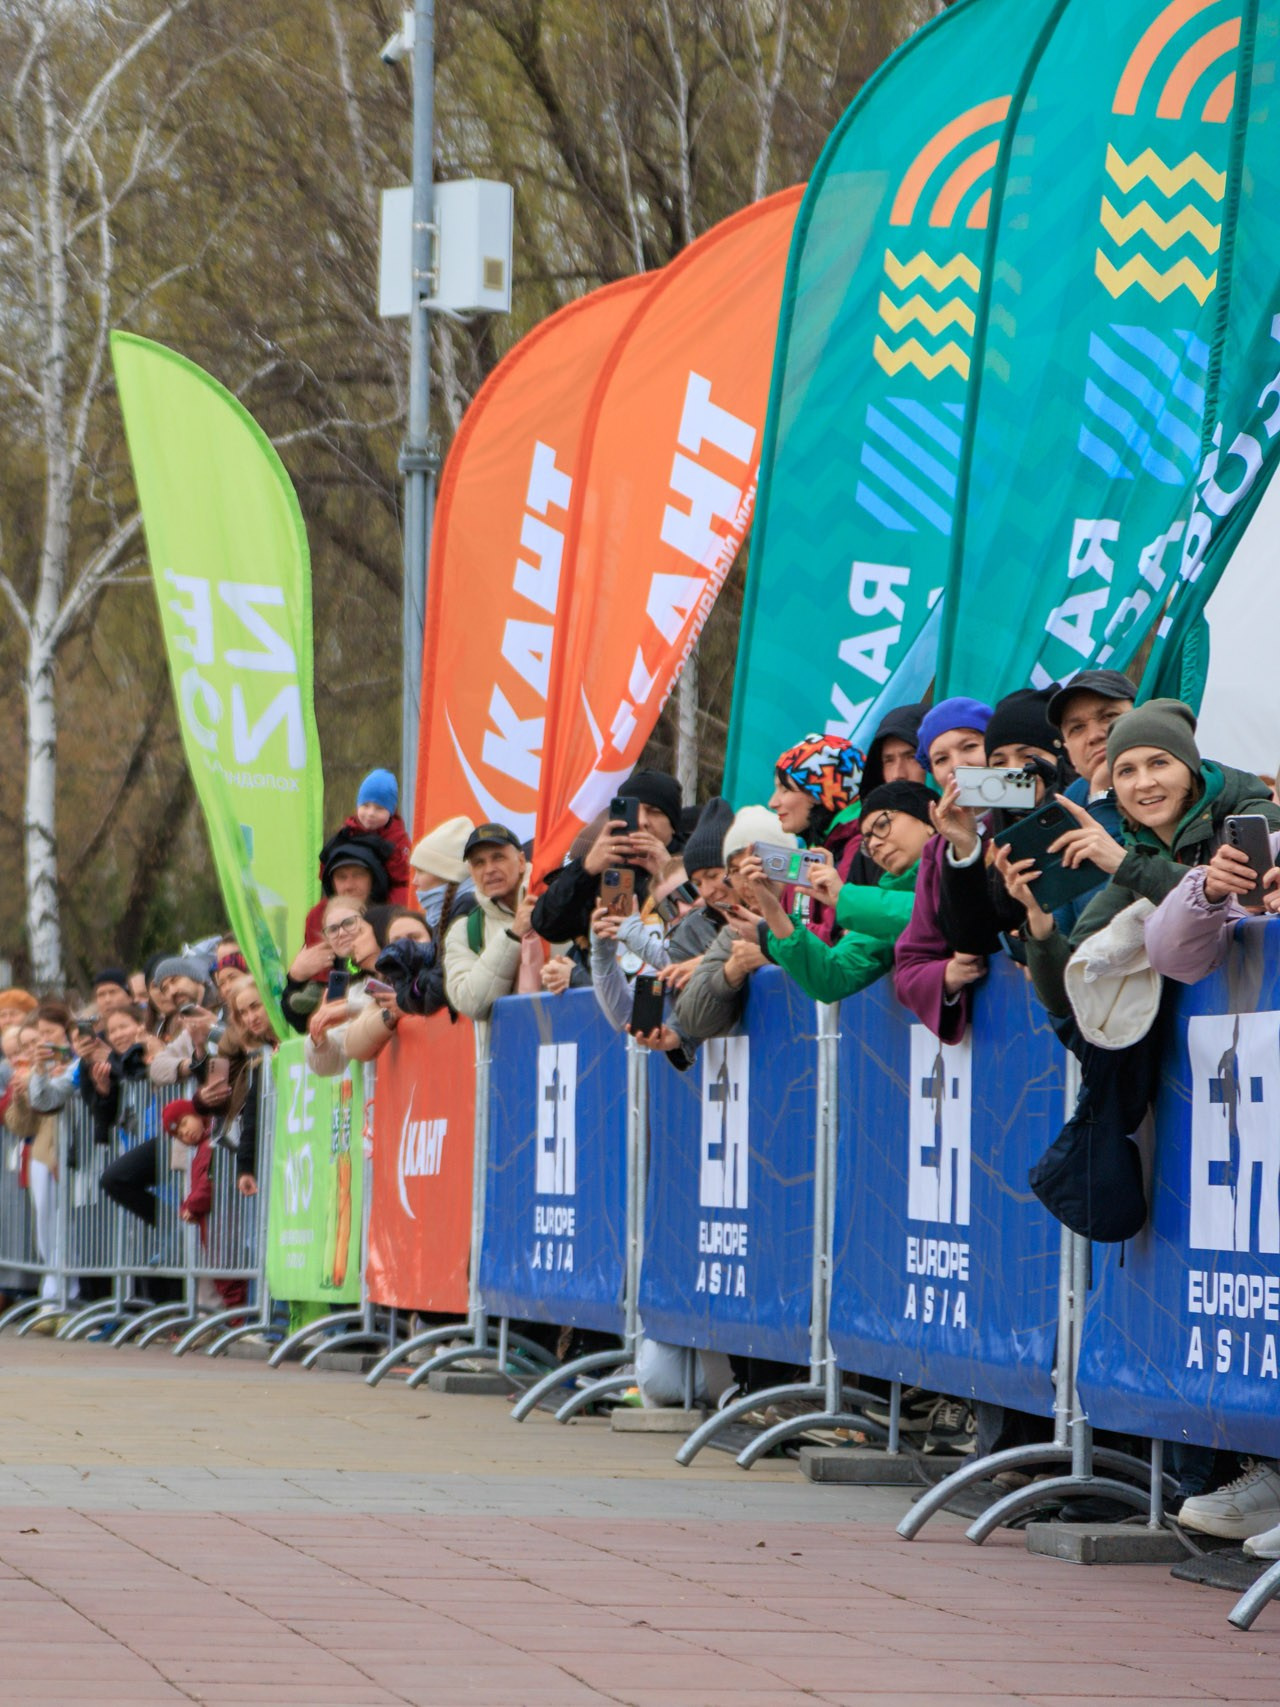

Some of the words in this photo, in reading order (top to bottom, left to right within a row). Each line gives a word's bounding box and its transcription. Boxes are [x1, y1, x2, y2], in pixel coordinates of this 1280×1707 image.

[482, 440, 573, 791] КАНТ
[404, 1119, 448, 1176] КАНТ
[534, 1206, 575, 1236] EUROPE
[699, 1221, 747, 1256] EUROPE
[532, 1241, 573, 1272] ASIA
[695, 1261, 745, 1297] ASIA
[906, 1236, 969, 1281] EUROPE
[904, 1283, 966, 1329] ASIA
[1188, 1270, 1279, 1321] EUROPE
[1186, 1326, 1278, 1379] ASIA
